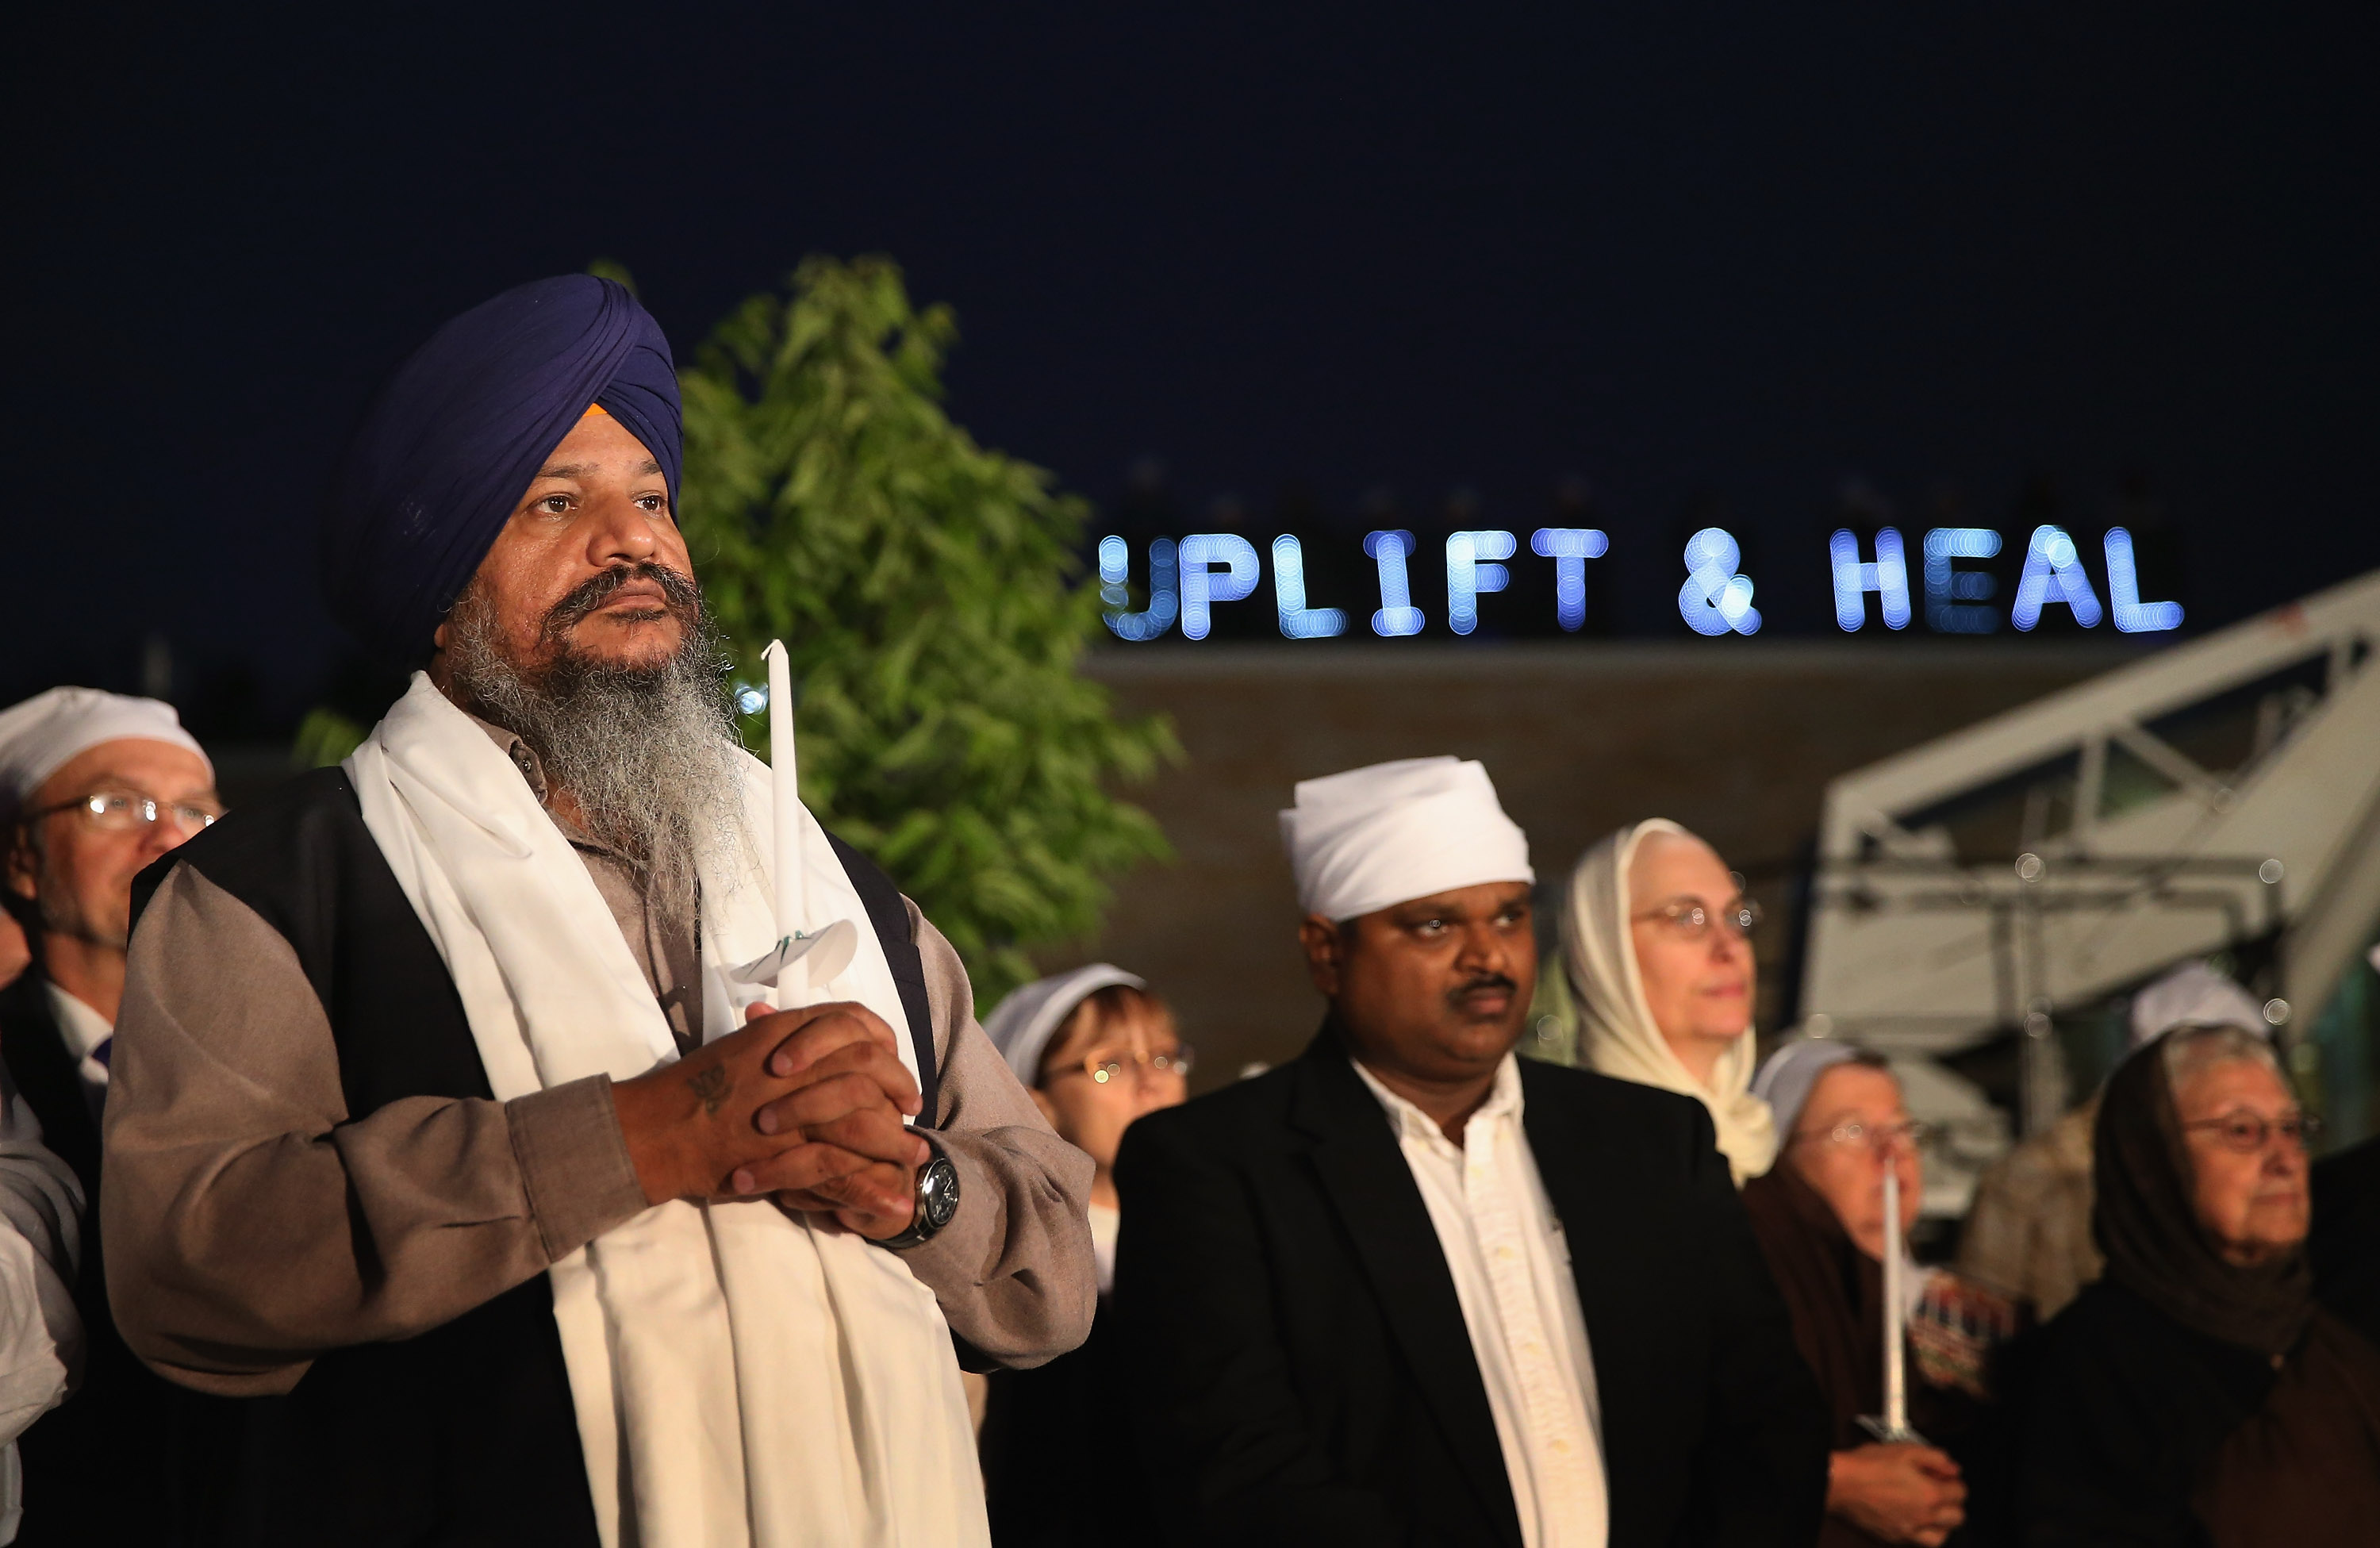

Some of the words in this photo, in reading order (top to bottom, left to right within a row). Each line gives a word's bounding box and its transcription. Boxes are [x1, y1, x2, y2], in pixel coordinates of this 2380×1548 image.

[1098, 528, 1610, 641] UPLIFT
[1677, 527, 1763, 636] &
[1829, 524, 2185, 636] HEAL
